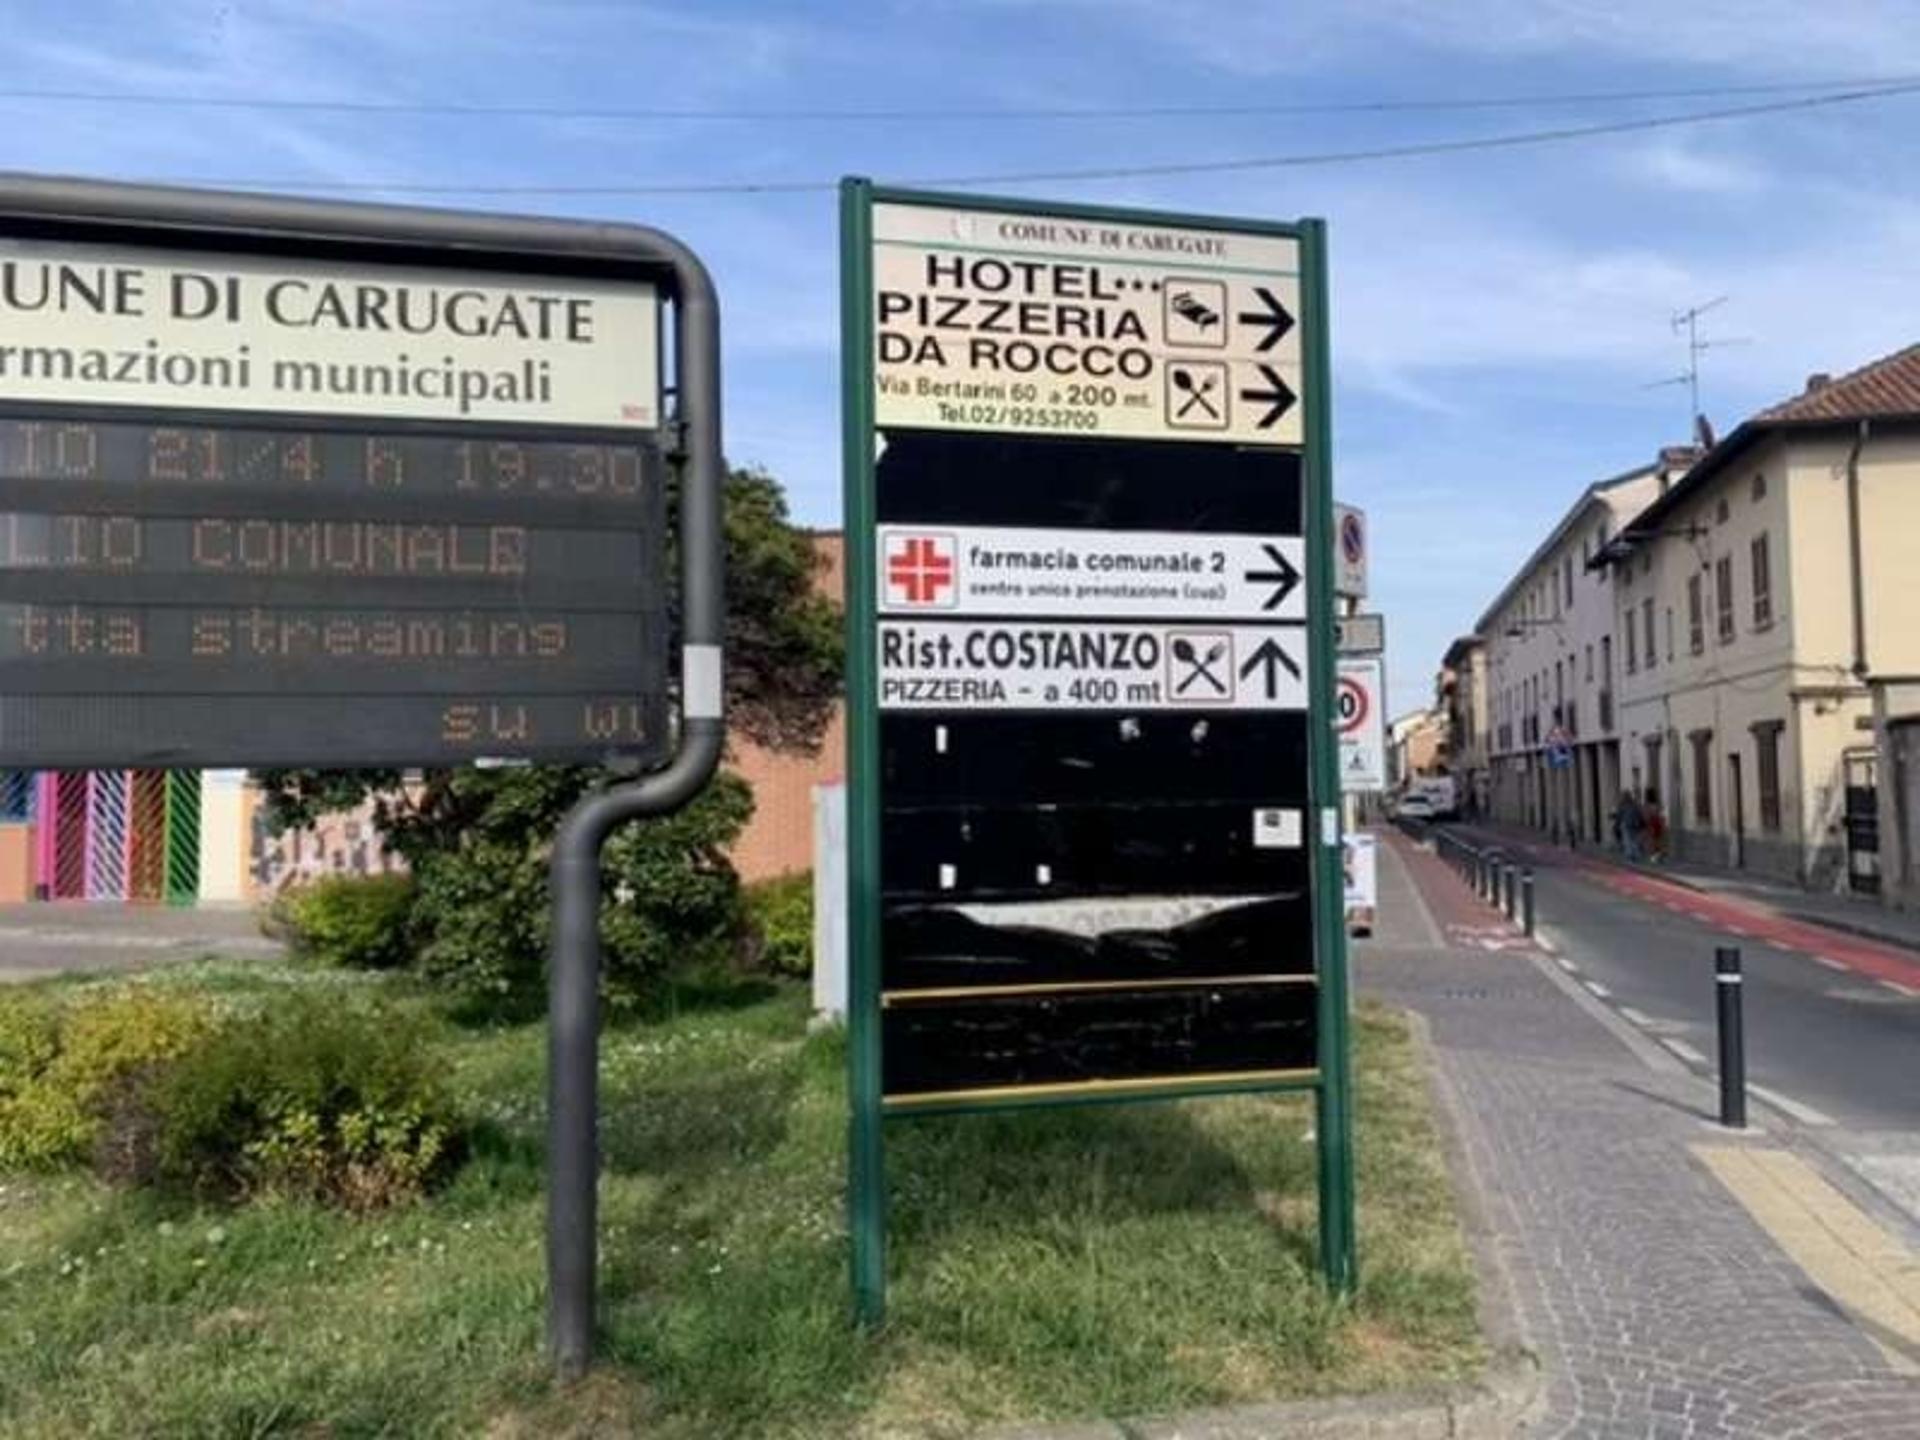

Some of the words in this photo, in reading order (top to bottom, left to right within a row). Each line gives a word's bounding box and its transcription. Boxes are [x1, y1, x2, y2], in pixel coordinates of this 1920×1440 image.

[999, 221, 1090, 244] COMUNE
[1099, 230, 1121, 249] DI
[1126, 232, 1227, 256] CARUGATE
[2, 262, 145, 317] UNE
[170, 273, 240, 323] DI
[265, 279, 595, 344] CARUGATE
[878, 291, 1149, 342] PIZZERIA
[0, 338, 251, 388] rmazioni
[273, 353, 552, 414] municipali
[879, 331, 947, 367] DA
[969, 340, 1154, 380] ROCCO
[878, 375, 910, 395] Via
[916, 377, 1006, 401] Bertarini
[1010, 383, 1038, 403] 60
[1067, 385, 1117, 407] 200
[455, 441, 643, 494] 19.30
[192, 518, 526, 572] COMUNALE
[970, 547, 1079, 571] farmacia
[1085, 551, 1204, 573] comunale
[1211, 551, 1227, 573] 2
[192, 607, 566, 655] streaming
[883, 679, 1006, 701] PIZZERIA
[1044, 685, 1059, 701] a
[1068, 680, 1118, 702] 400
[1127, 681, 1161, 702] mt
